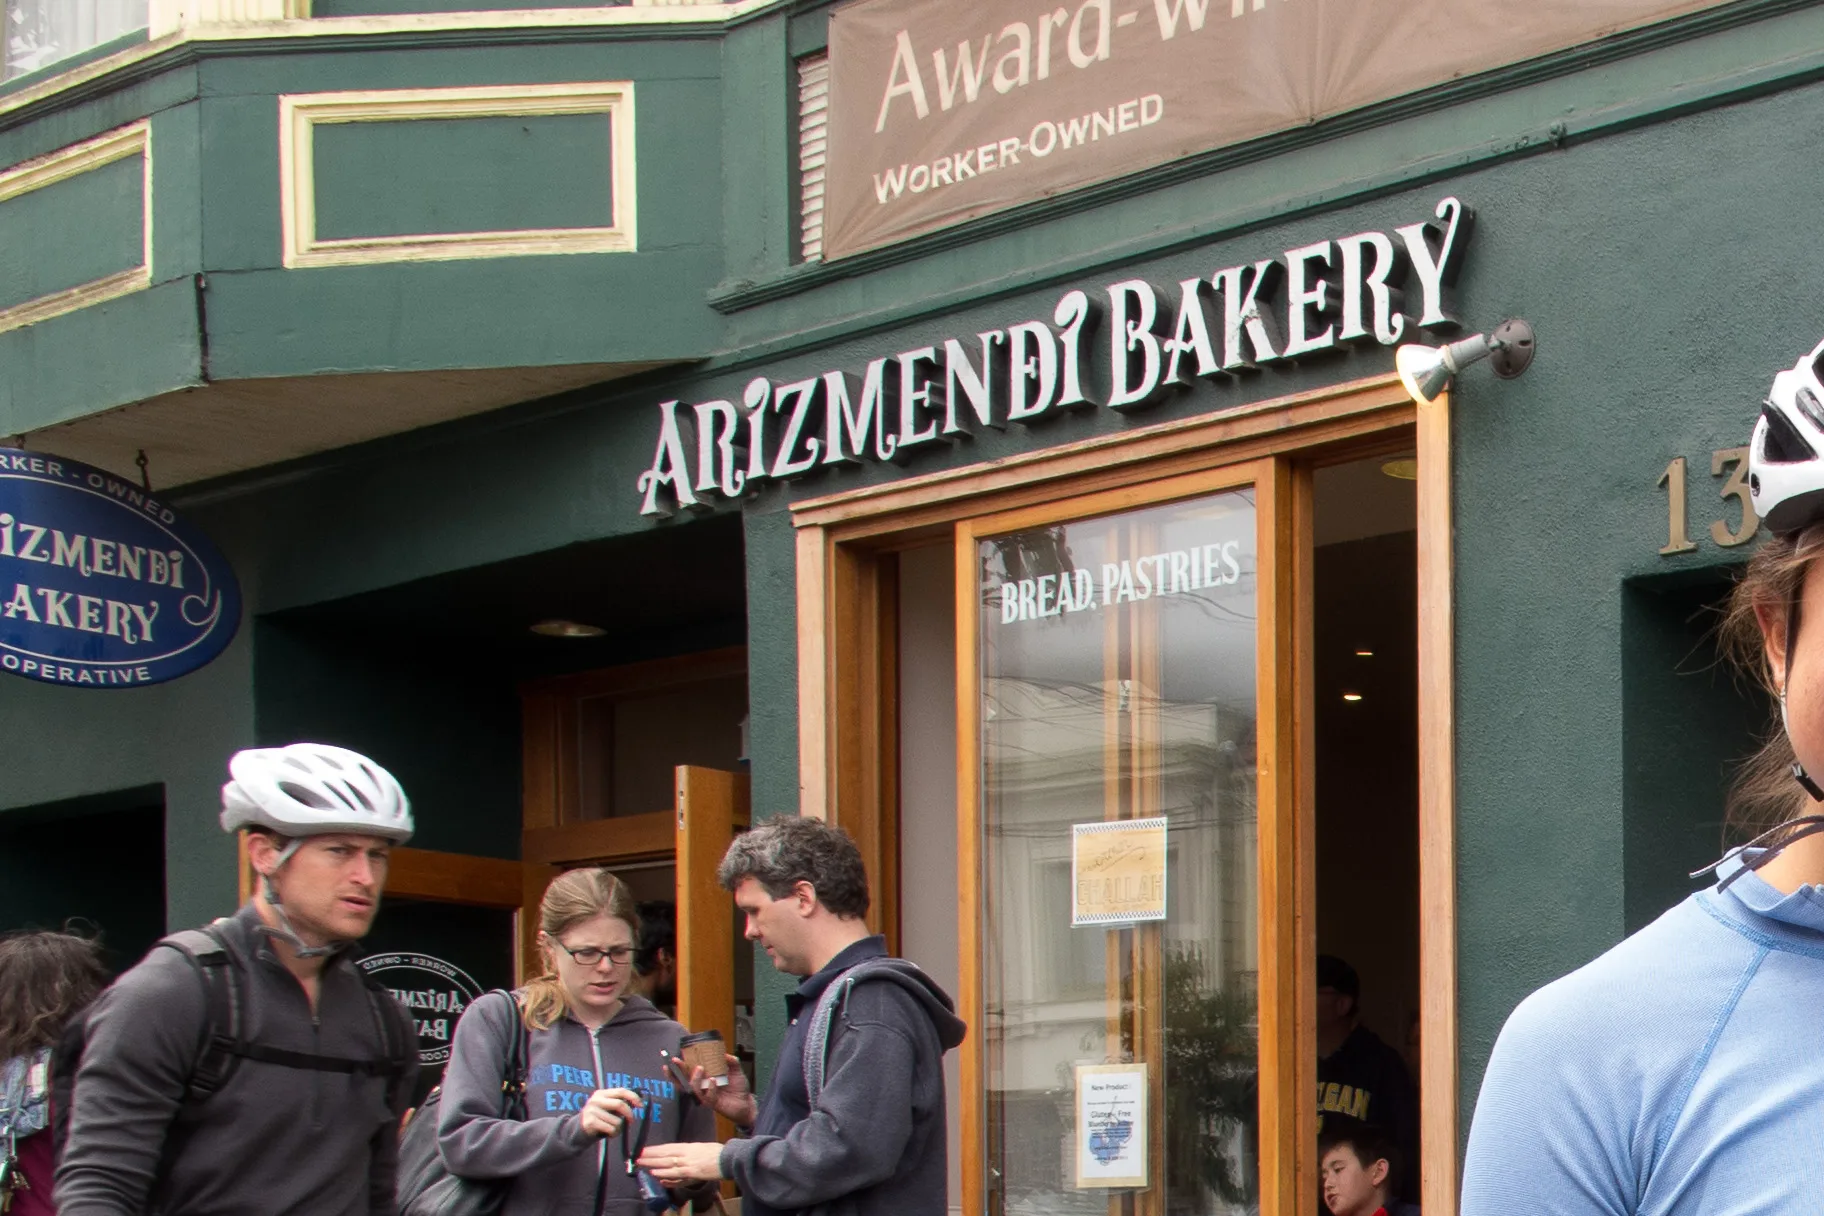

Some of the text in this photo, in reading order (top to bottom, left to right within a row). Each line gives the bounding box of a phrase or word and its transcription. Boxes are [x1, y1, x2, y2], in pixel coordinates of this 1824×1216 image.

[1106, 197, 1462, 408] BAKERY
[87, 473, 176, 525] OWNED
[1101, 540, 1240, 606] PASTRIES
[0, 584, 159, 645] AKERY
[2, 654, 152, 684] OPERATIVE
[551, 1063, 595, 1088] PEER
